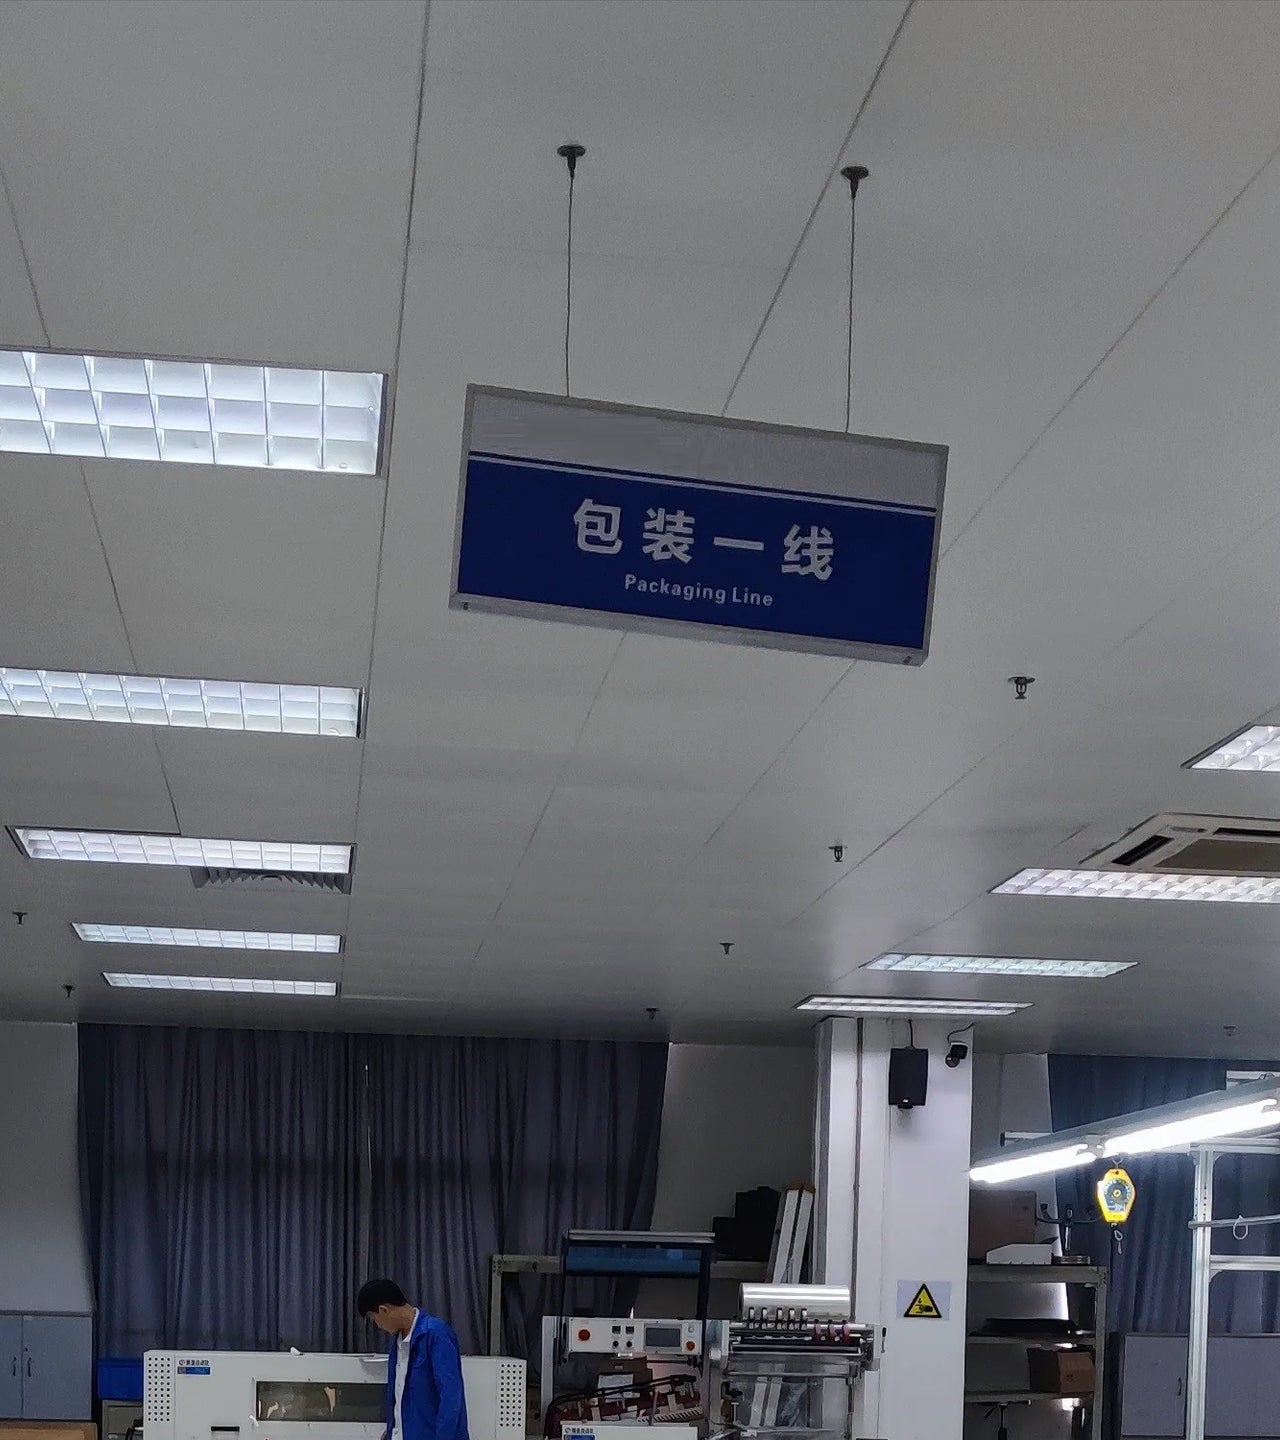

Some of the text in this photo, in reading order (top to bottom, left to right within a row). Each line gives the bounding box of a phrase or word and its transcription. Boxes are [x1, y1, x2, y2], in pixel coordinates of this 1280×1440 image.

[572, 498, 834, 581] 包装一线
[624, 573, 774, 607] Packaging Line
